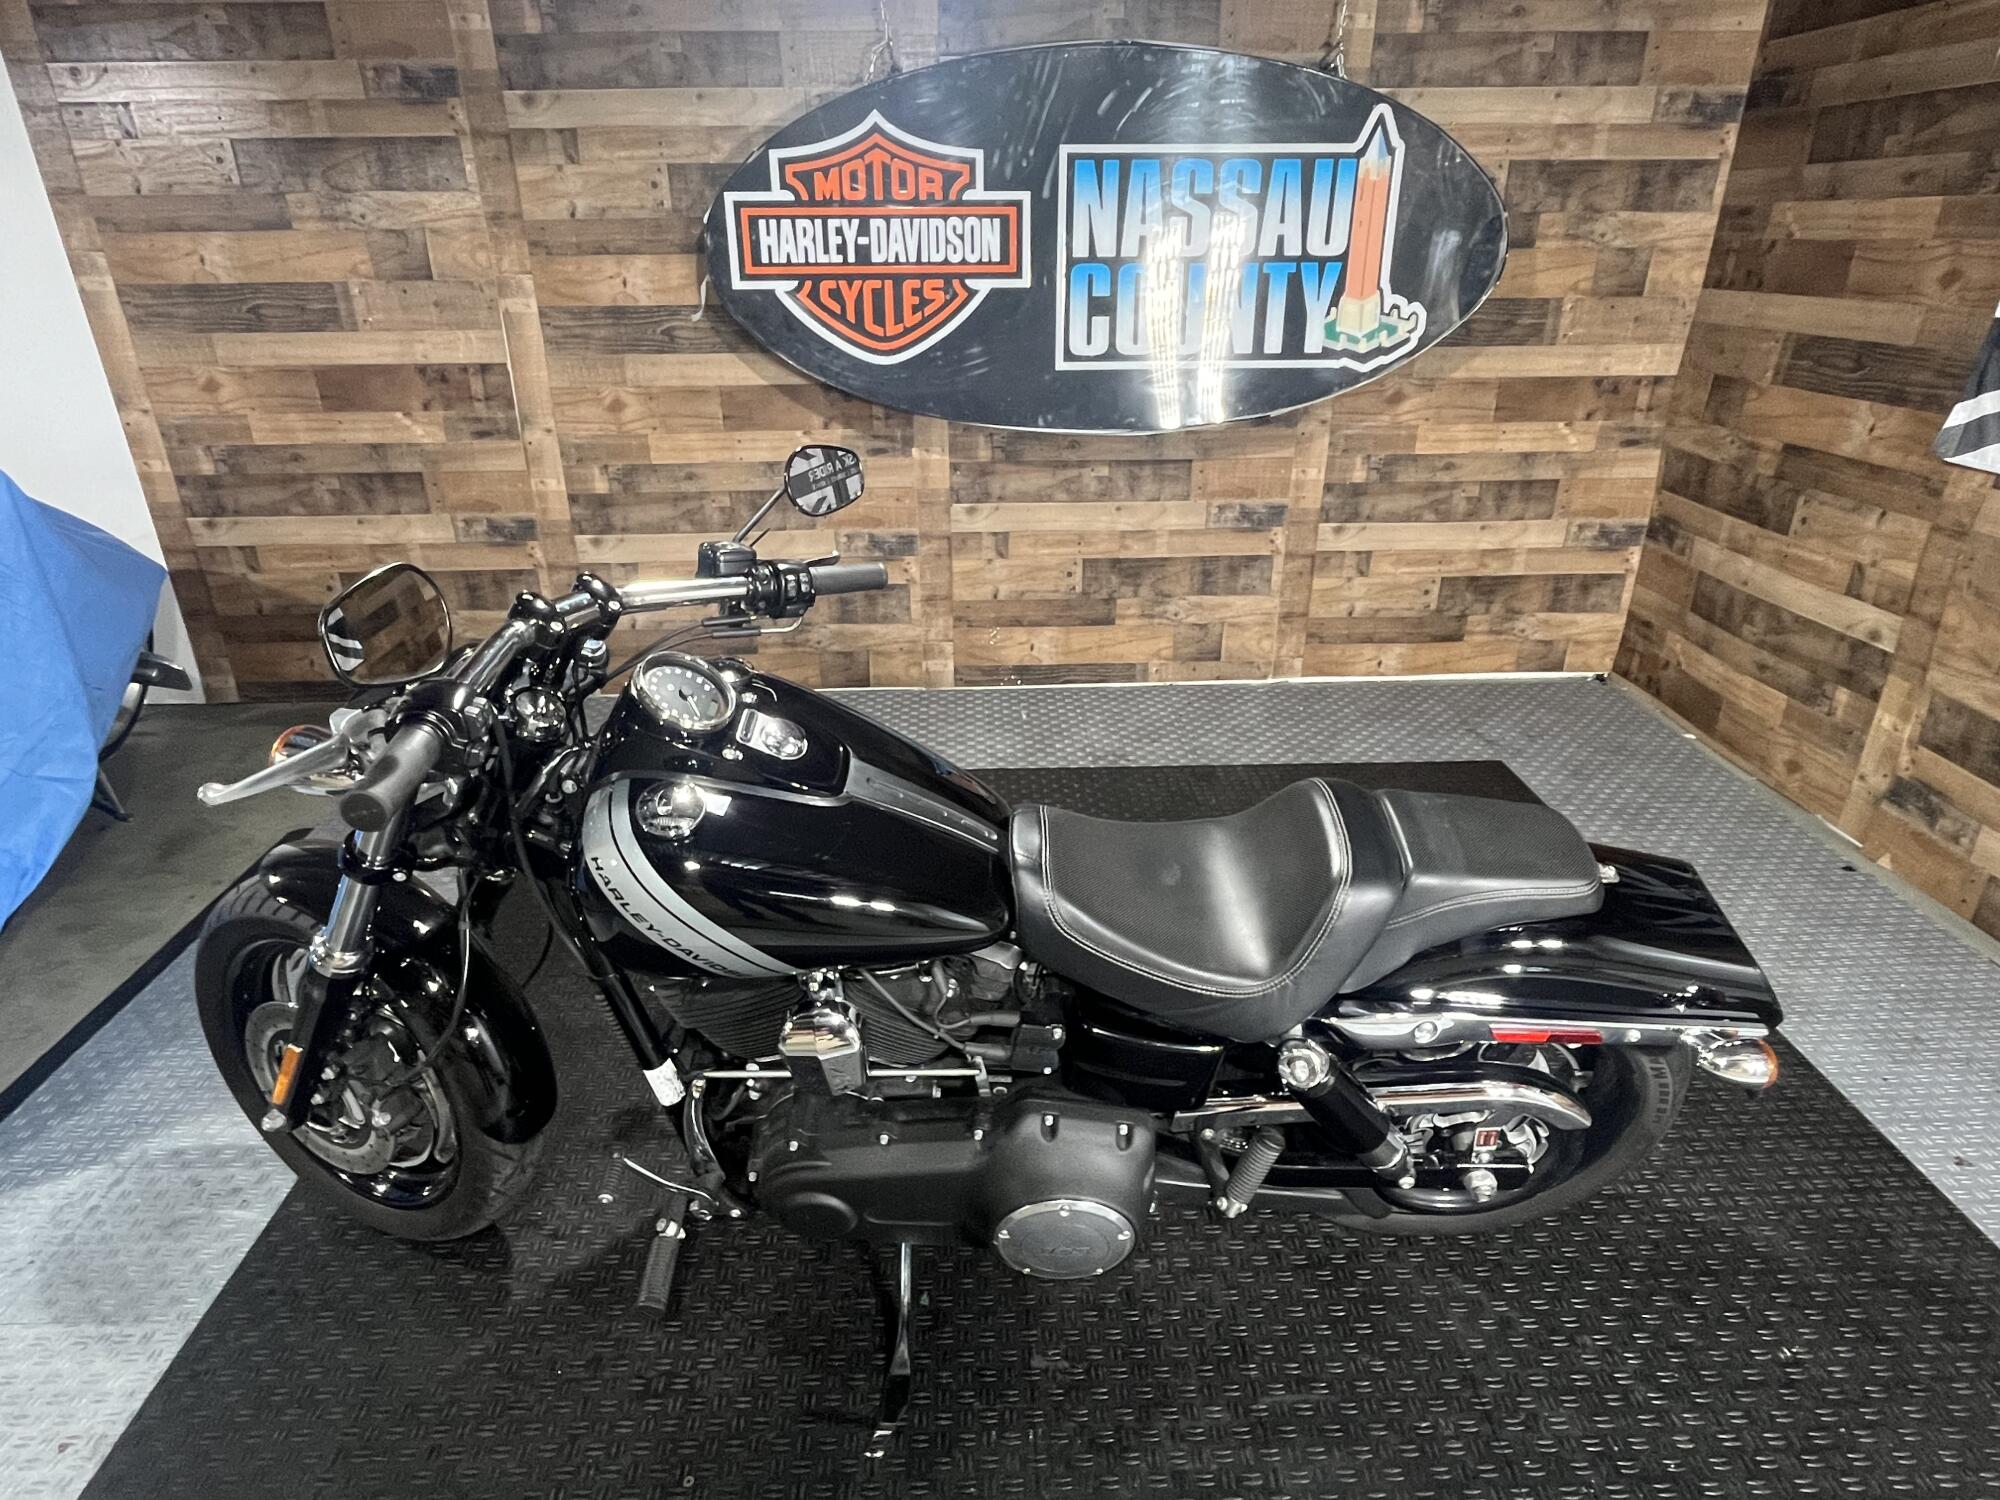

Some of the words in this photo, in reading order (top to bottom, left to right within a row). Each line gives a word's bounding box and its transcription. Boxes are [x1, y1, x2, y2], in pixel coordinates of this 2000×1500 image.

[813, 147, 945, 202] MOTOR
[1072, 158, 1357, 258] NASSAU
[758, 217, 1001, 265] HARLEY-DAVIDSON
[818, 279, 946, 338] CYCLES
[1068, 262, 1343, 355] COUNTY
